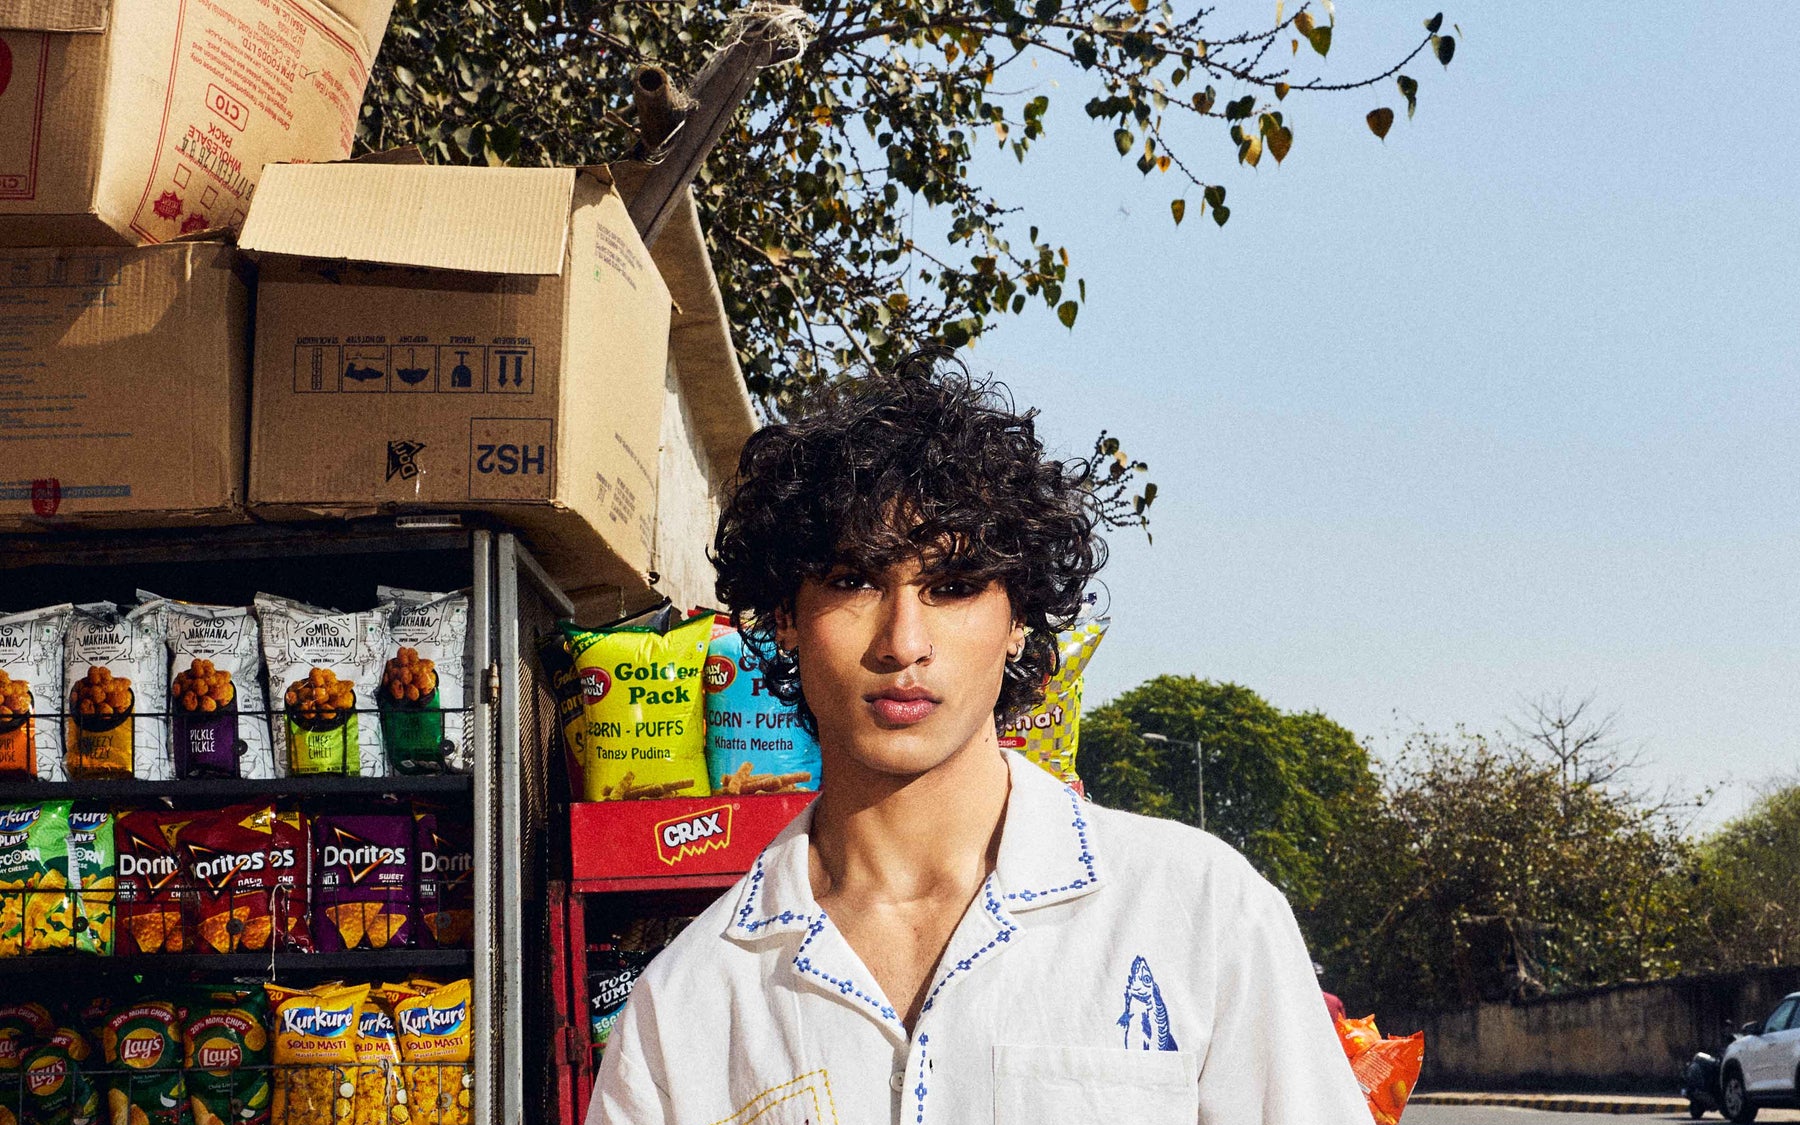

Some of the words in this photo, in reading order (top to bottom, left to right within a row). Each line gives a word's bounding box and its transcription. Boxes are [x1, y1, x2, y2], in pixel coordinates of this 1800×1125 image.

[239, 35, 256, 54] LTD.
[255, 46, 280, 72] FOODS
[279, 65, 295, 83] DFM
[214, 95, 241, 121] C10
[206, 121, 232, 149] PACK
[186, 123, 242, 173] WHOLESALE
[449, 335, 476, 343] FRAGILE
[477, 444, 545, 474] HS2
[306, 623, 339, 637] MR
[400, 616, 431, 628] AKHANA
[83, 635, 120, 646] MAKHANA
[189, 629, 228, 640] MAKHANA
[300, 636, 345, 648] MAKHANA
[614, 662, 699, 681] Golden
[629, 685, 691, 704] Pack
[636, 721, 684, 738] PUFFS
[709, 711, 742, 727] CORN
[756, 712, 802, 729] PUFFS
[190, 729, 214, 740] PICKLE
[715, 737, 746, 750] Khatta
[750, 738, 793, 751] Meetha
[191, 740, 216, 752] TICKLE
[596, 747, 627, 760] Tangy
[632, 747, 671, 759] Pudina
[0, 809, 40, 827] rkure
[663, 813, 723, 847] CRAX
[119, 853, 177, 876] Dorit
[195, 849, 264, 880] oritos
[323, 845, 407, 867] Doritos
[420, 851, 471, 873] Dorit
[599, 971, 632, 993] TOO
[270, 991, 283, 1001] 20
[386, 992, 399, 1003] 20
[113, 1012, 128, 1027] 20%
[129, 1008, 149, 1018] MORE
[150, 1008, 172, 1022] CHIPS
[225, 1015, 247, 1031] CHIPS
[283, 1006, 353, 1037] Kurkure
[399, 1006, 466, 1037] Kurkure
[124, 1039, 162, 1060] Lay's
[287, 1040, 315, 1049] SOLID
[317, 1040, 347, 1049] MASTI
[406, 1040, 434, 1051] SOLID
[436, 1036, 464, 1048] MASTI
[203, 1047, 239, 1068] Lay's
[30, 1060, 66, 1088] Lay's
